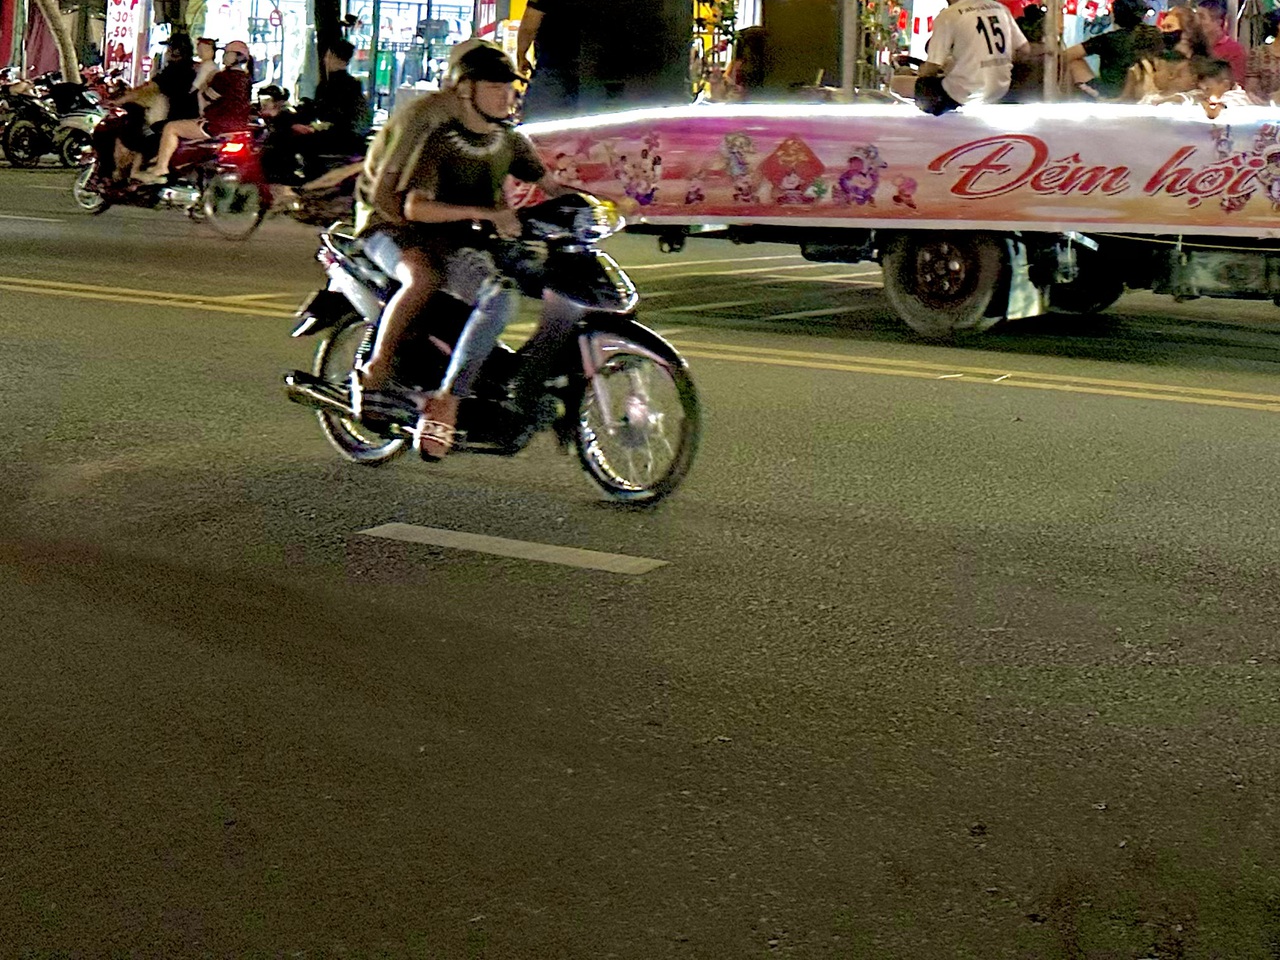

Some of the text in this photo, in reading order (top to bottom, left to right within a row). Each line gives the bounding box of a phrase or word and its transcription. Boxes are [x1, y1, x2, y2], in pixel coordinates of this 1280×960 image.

[976, 15, 1005, 54] 15
[928, 134, 1130, 200] Đêm
[1143, 145, 1267, 208] hội
